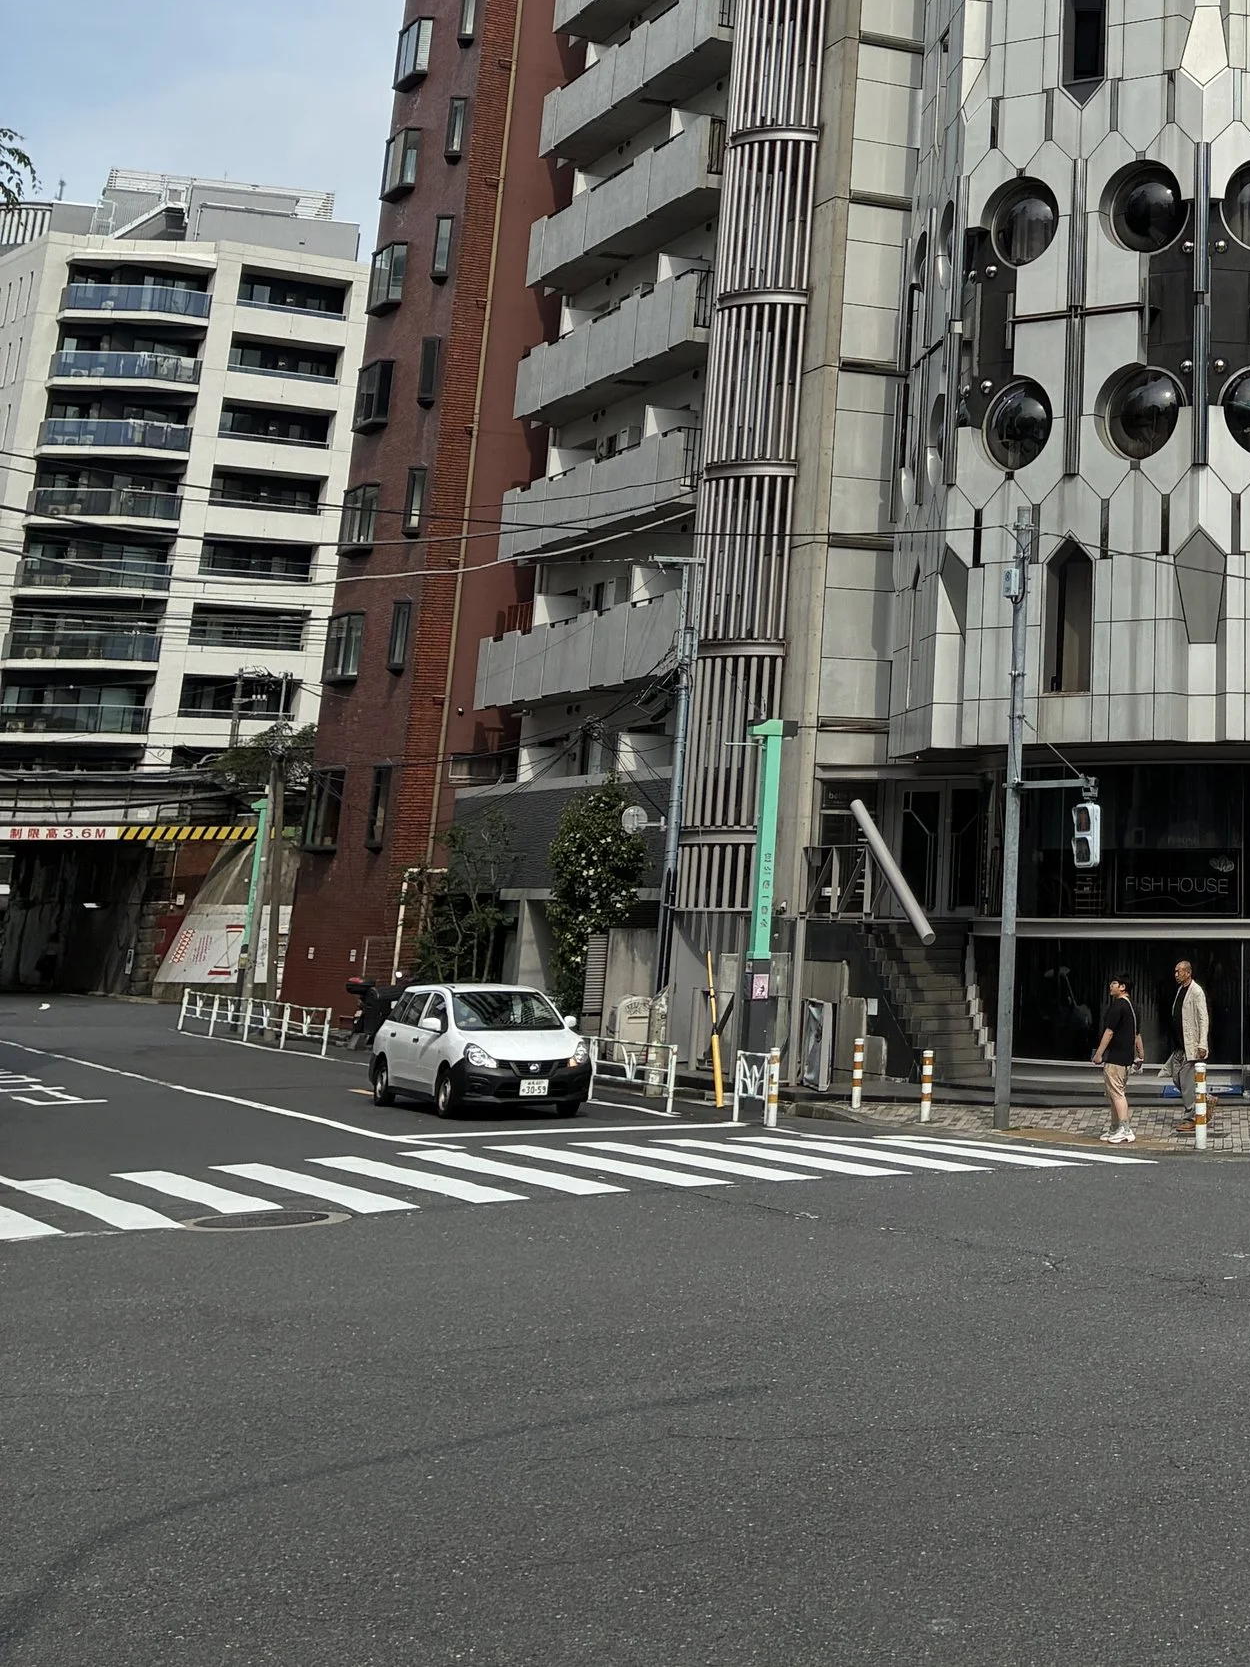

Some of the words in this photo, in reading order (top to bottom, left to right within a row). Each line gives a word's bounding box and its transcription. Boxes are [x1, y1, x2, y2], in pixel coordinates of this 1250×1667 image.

[9, 828, 107, 839] 制限高3.6M
[1125, 876, 1164, 892] FISH
[1167, 876, 1229, 895] HOUSE
[525, 1085, 547, 1095] 30-59
